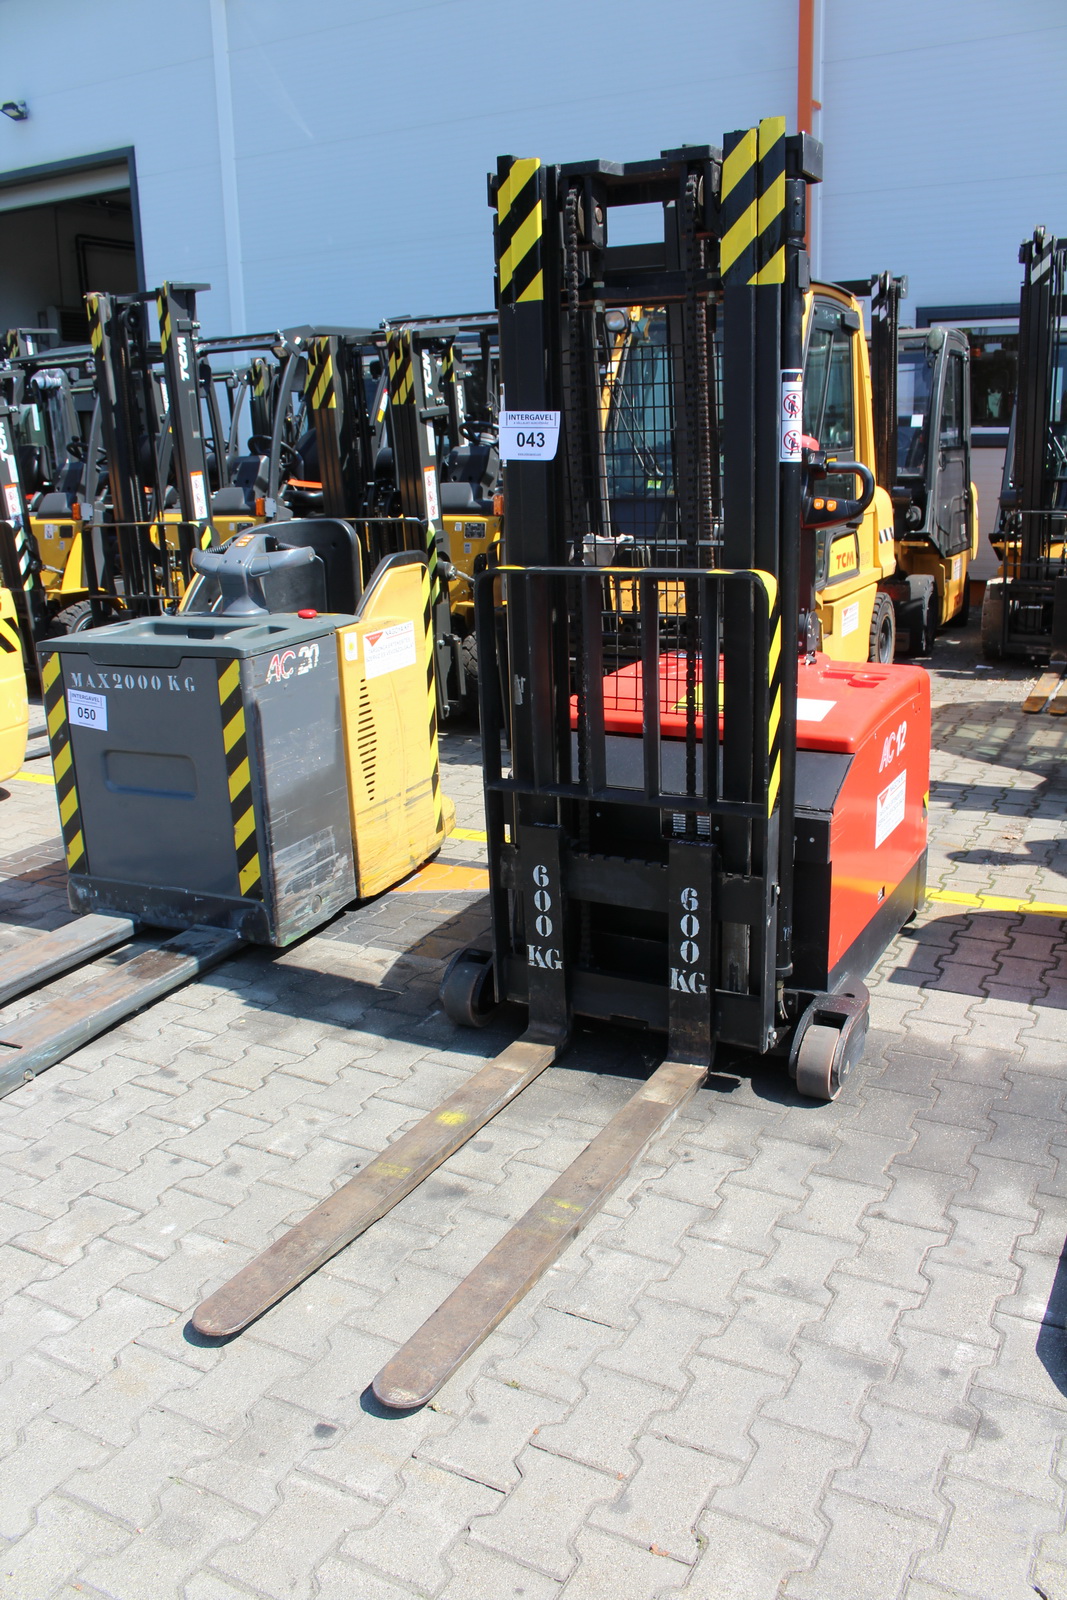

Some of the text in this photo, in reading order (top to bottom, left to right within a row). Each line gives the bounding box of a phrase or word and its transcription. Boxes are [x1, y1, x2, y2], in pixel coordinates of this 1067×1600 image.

[177, 337, 189, 381] TCM
[422, 351, 433, 398] TCM
[508, 413, 553, 421] INTERGAVEL
[516, 431, 546, 448] 043
[836, 551, 855, 570] TCM
[167, 675, 196, 692] KG
[72, 692, 100, 703] INTERGAVEL
[77, 706, 96, 721] 050
[532, 864, 553, 938] 600
[680, 887, 700, 964] 600
[527, 944, 563, 970] KG
[670, 967, 708, 994] KG
